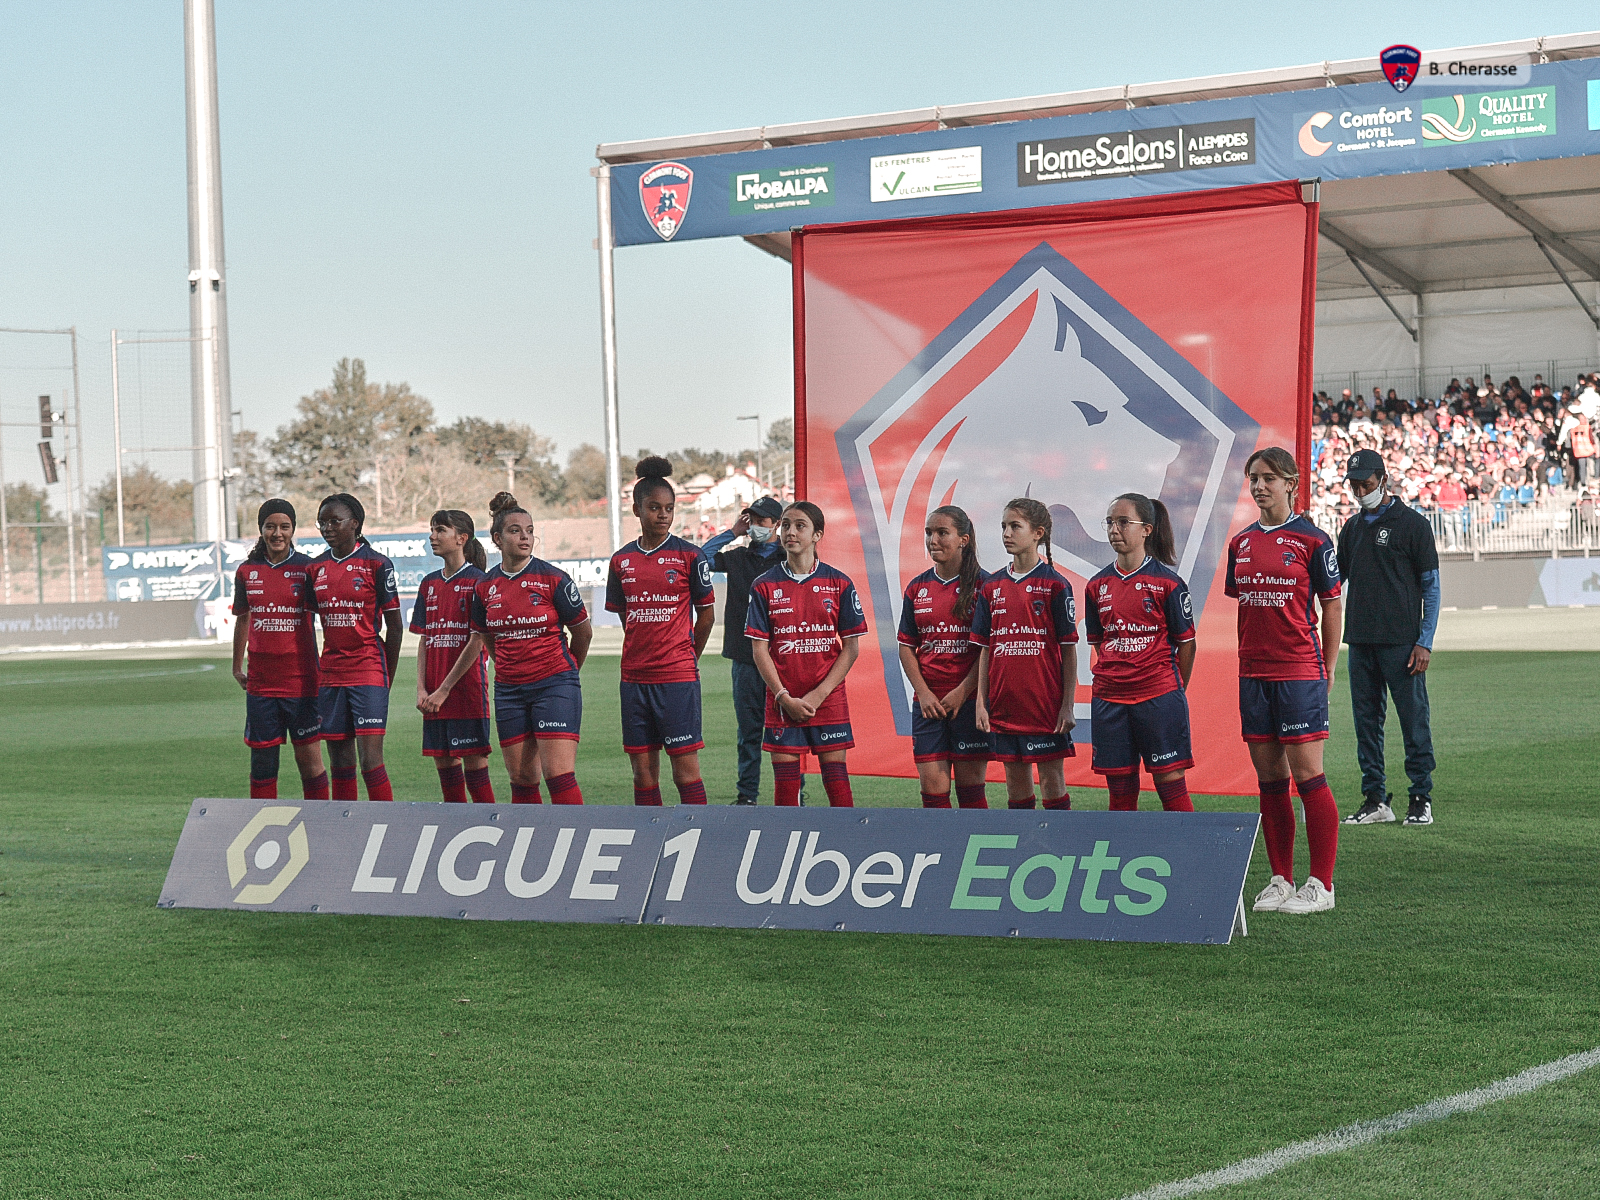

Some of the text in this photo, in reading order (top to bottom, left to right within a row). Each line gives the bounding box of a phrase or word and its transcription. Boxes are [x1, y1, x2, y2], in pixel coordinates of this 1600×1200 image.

[1479, 93, 1548, 116] QUALITY
[1339, 106, 1412, 128] Comfort
[1492, 112, 1534, 124] HOTEL
[1356, 127, 1394, 140] HOTEL
[1480, 124, 1548, 137] Clermont Kennedy
[1198, 132, 1248, 150] LEMPDES
[1337, 142, 1370, 152] Clermont
[1024, 134, 1176, 174] HomeSalons
[1188, 154, 1213, 166] Face
[1222, 150, 1248, 162] Cora
[892, 156, 930, 166] FENÊTRES
[744, 176, 829, 200] MOBALPA
[661, 223, 672, 231] 63
[132, 548, 214, 572] PATRICK
[1266, 576, 1297, 585] Mutuel
[1250, 591, 1294, 600] CLERMONT
[636, 607, 677, 616] CLERMONT
[518, 614, 547, 624] Mutuel
[774, 625, 796, 634] Crédit
[1021, 626, 1047, 635] Mutuel
[1127, 623, 1158, 631] Mutuel
[795, 637, 837, 646] CLERMONT
[1005, 641, 1046, 649] CLERMONT
[795, 645, 830, 653] FERRAND
[672, 734, 692, 742] VEOLIA
[1158, 751, 1178, 760] VEOLIA
[352, 824, 1172, 916] LIGUE 1 Uber Eats
